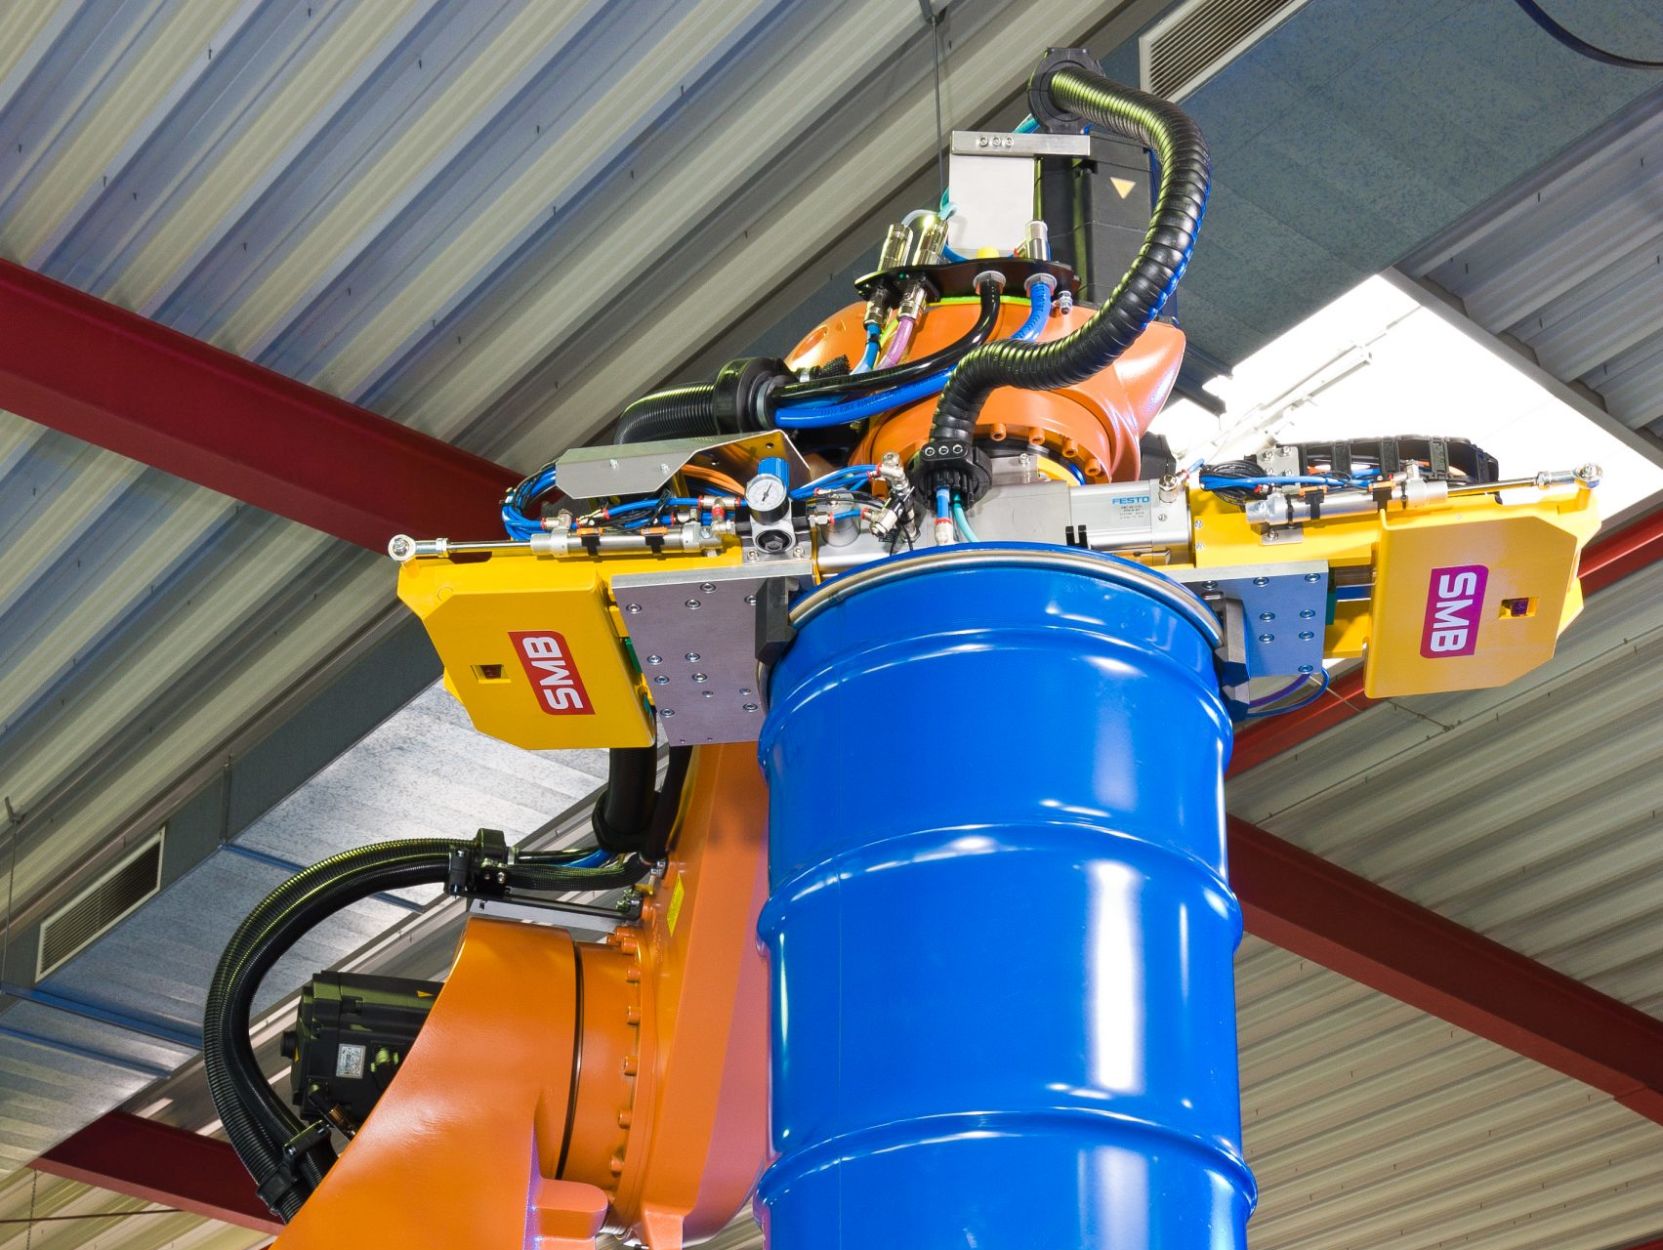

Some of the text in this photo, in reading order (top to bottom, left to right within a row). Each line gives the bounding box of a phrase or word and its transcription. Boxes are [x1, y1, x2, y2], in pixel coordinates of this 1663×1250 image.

[1112, 496, 1150, 505] FESTO
[1430, 572, 1477, 652] SMB
[522, 636, 584, 710] SMB
